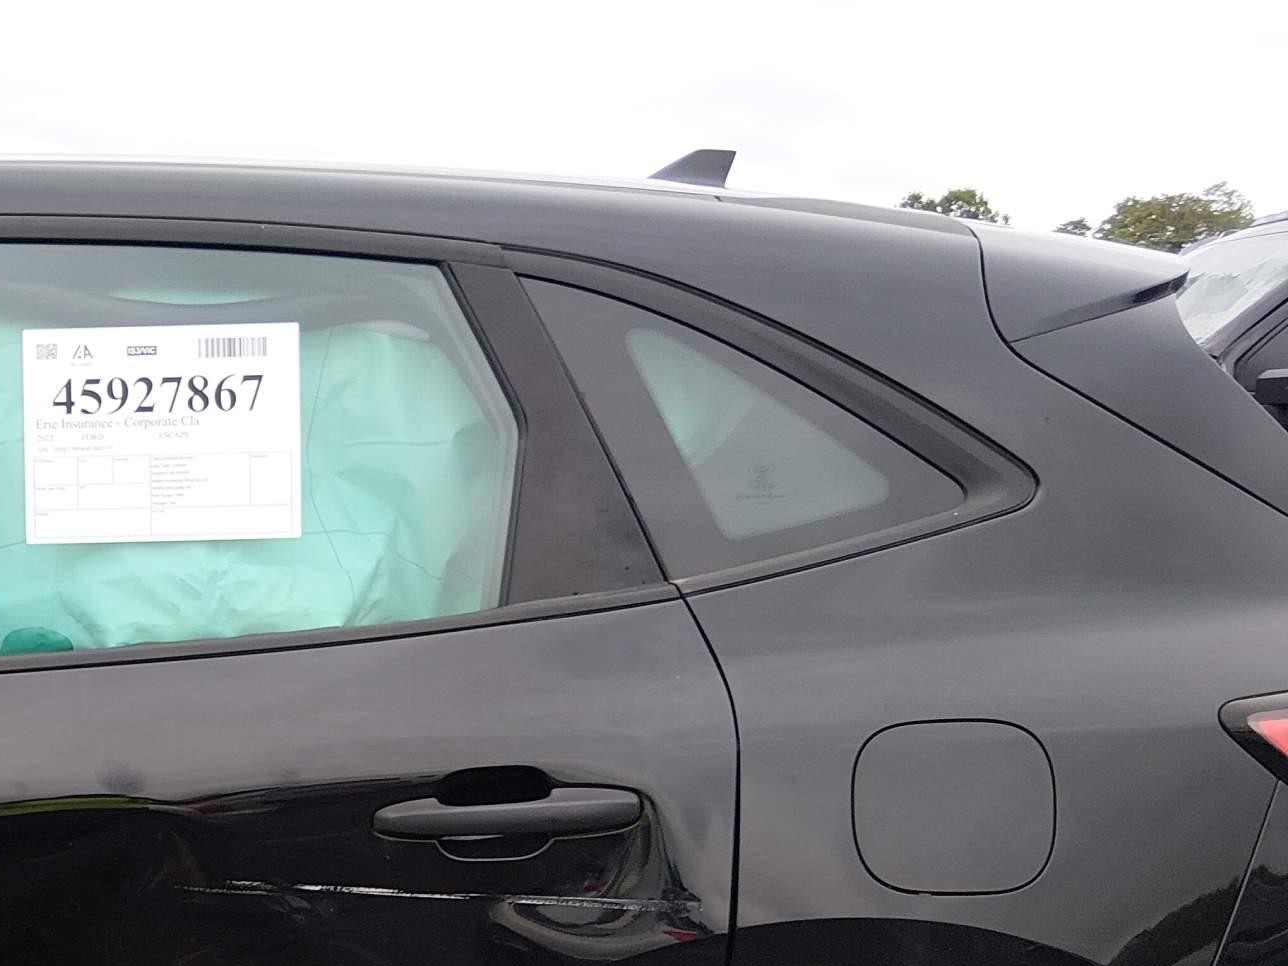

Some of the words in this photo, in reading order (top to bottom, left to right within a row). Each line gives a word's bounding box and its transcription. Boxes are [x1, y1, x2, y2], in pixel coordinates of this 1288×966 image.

[52, 373, 264, 415] 45927867
[61, 416, 113, 429] Insurance
[123, 415, 179, 431] Corporate
[180, 415, 200, 427] Cla
